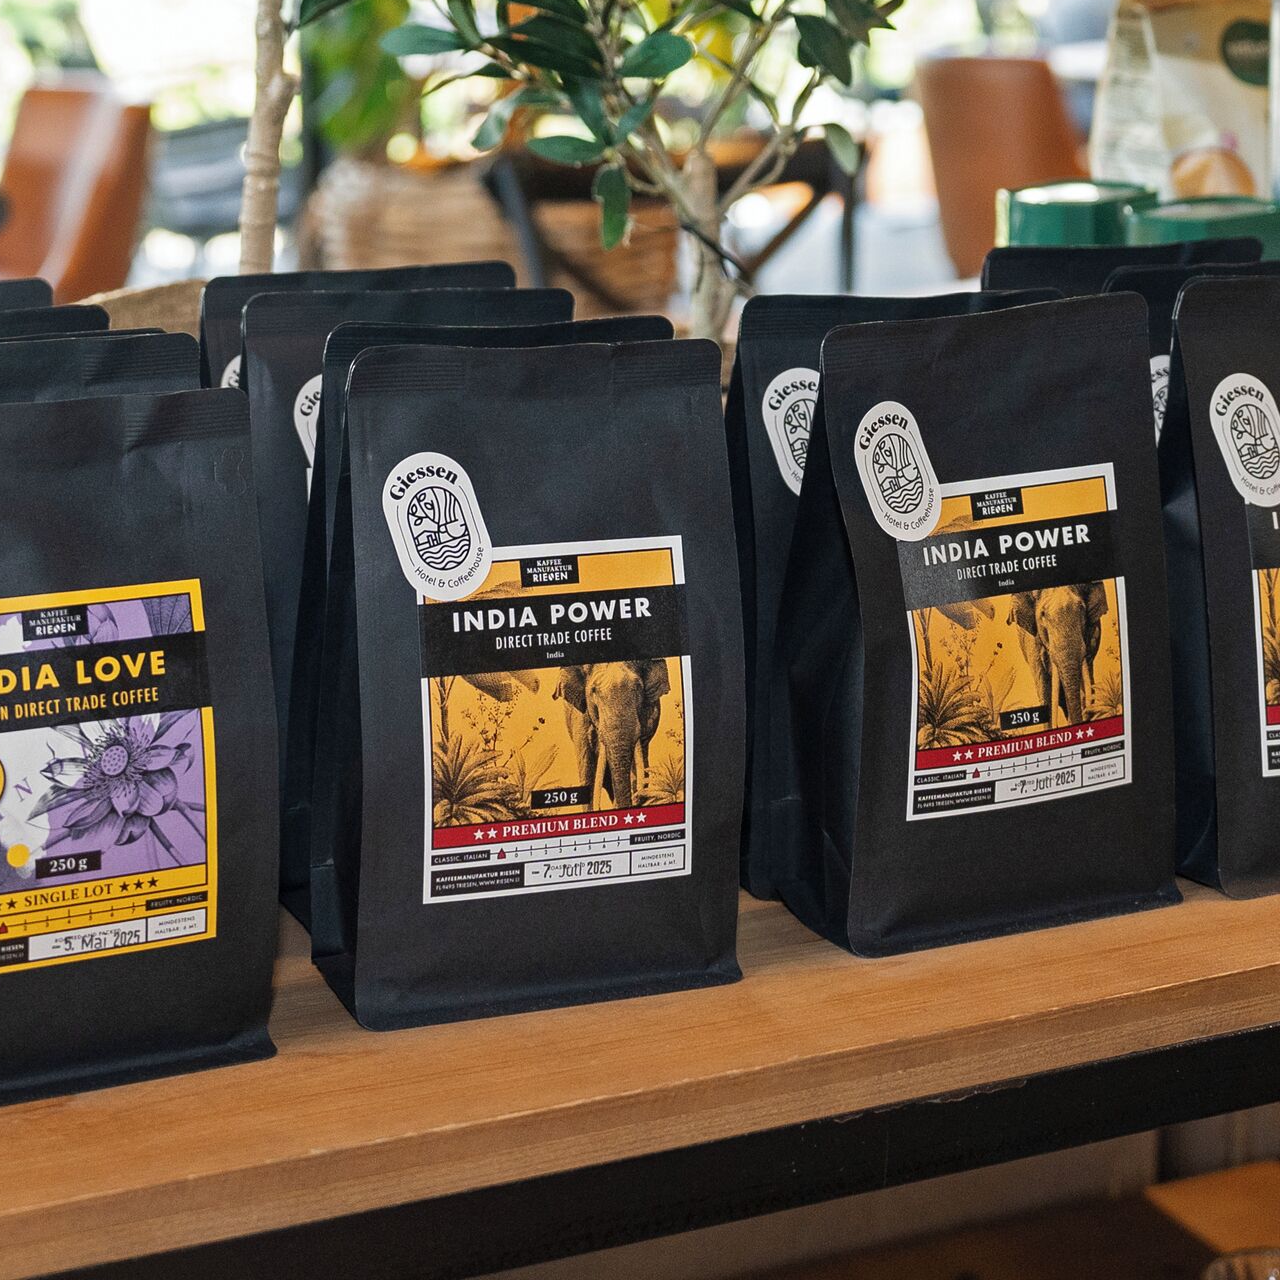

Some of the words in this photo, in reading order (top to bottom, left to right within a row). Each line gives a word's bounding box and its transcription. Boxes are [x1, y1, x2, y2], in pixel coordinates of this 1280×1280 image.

[1214, 384, 1265, 417] Giessen
[859, 413, 910, 451] Giessen
[389, 465, 459, 501] Giessen
[1241, 476, 1259, 494] Hotel
[1259, 486, 1266, 495] &
[976, 497, 1018, 508] MANUFAKTUR
[984, 492, 1008, 500] KAFFEE
[883, 512, 902, 530] Hotel
[903, 521, 910, 531] &
[910, 488, 935, 531] Coffeehouse
[923, 538, 990, 566] INDIA
[999, 524, 1091, 555] POWER
[414, 566, 437, 587] Hotel
[438, 579, 446, 588] &
[448, 547, 484, 589] Coffeehouse
[526, 564, 573, 575] MANUFAKTUR
[536, 559, 563, 567] KAFFEE
[957, 563, 987, 581] DIRECT
[990, 559, 1020, 576] TRADE
[1022, 554, 1058, 571] COFFEE
[998, 579, 1015, 588] India
[29, 614, 82, 627] MANUFAKTUR
[39, 609, 69, 618] KAFFEE
[452, 606, 538, 633] INDIA
[550, 597, 652, 625] POWER
[495, 634, 534, 650] DIRECT
[538, 630, 571, 647] TRADE
[574, 627, 613, 643] COFFEE
[546, 651, 565, 660] India
[76, 650, 166, 685] LOVE
[15, 699, 61, 718] DIRECT
[66, 693, 107, 712] TRADE
[111, 687, 159, 707] COFFEE
[1009, 711, 1031, 725] 250
[1032, 711, 1040, 724] g
[978, 738, 1033, 758] PREMIUM
[1036, 731, 1073, 748] BLEND
[942, 772, 965, 781] ITALIAN
[1055, 769, 1076, 787] 2025
[544, 791, 568, 804] 250
[570, 791, 578, 804] g
[917, 789, 973, 802] KAFFEEMANUFAKTUR
[973, 786, 992, 795] RIESEN
[502, 819, 569, 838] PREMIUM
[572, 814, 619, 830] BLEND
[634, 834, 656, 843] FRUITY,
[657, 831, 682, 840] NORDIC
[49, 857, 76, 873] 250
[78, 856, 88, 871] g
[463, 853, 488, 861] ITALIAN
[640, 852, 675, 861] MINDESTENS
[586, 859, 613, 875] 2025
[435, 871, 499, 883] KAFFEEMANUFAKTUR
[499, 869, 520, 877] RIESEN
[24, 887, 79, 908] SINGLE
[84, 883, 113, 899] LOT
[176, 894, 203, 904] NORDIC
[158, 915, 196, 926] MINDESTENS
[0, 943, 25, 953] RIESEN
[81, 936, 107, 951] Mai
[113, 929, 141, 947] 2025
